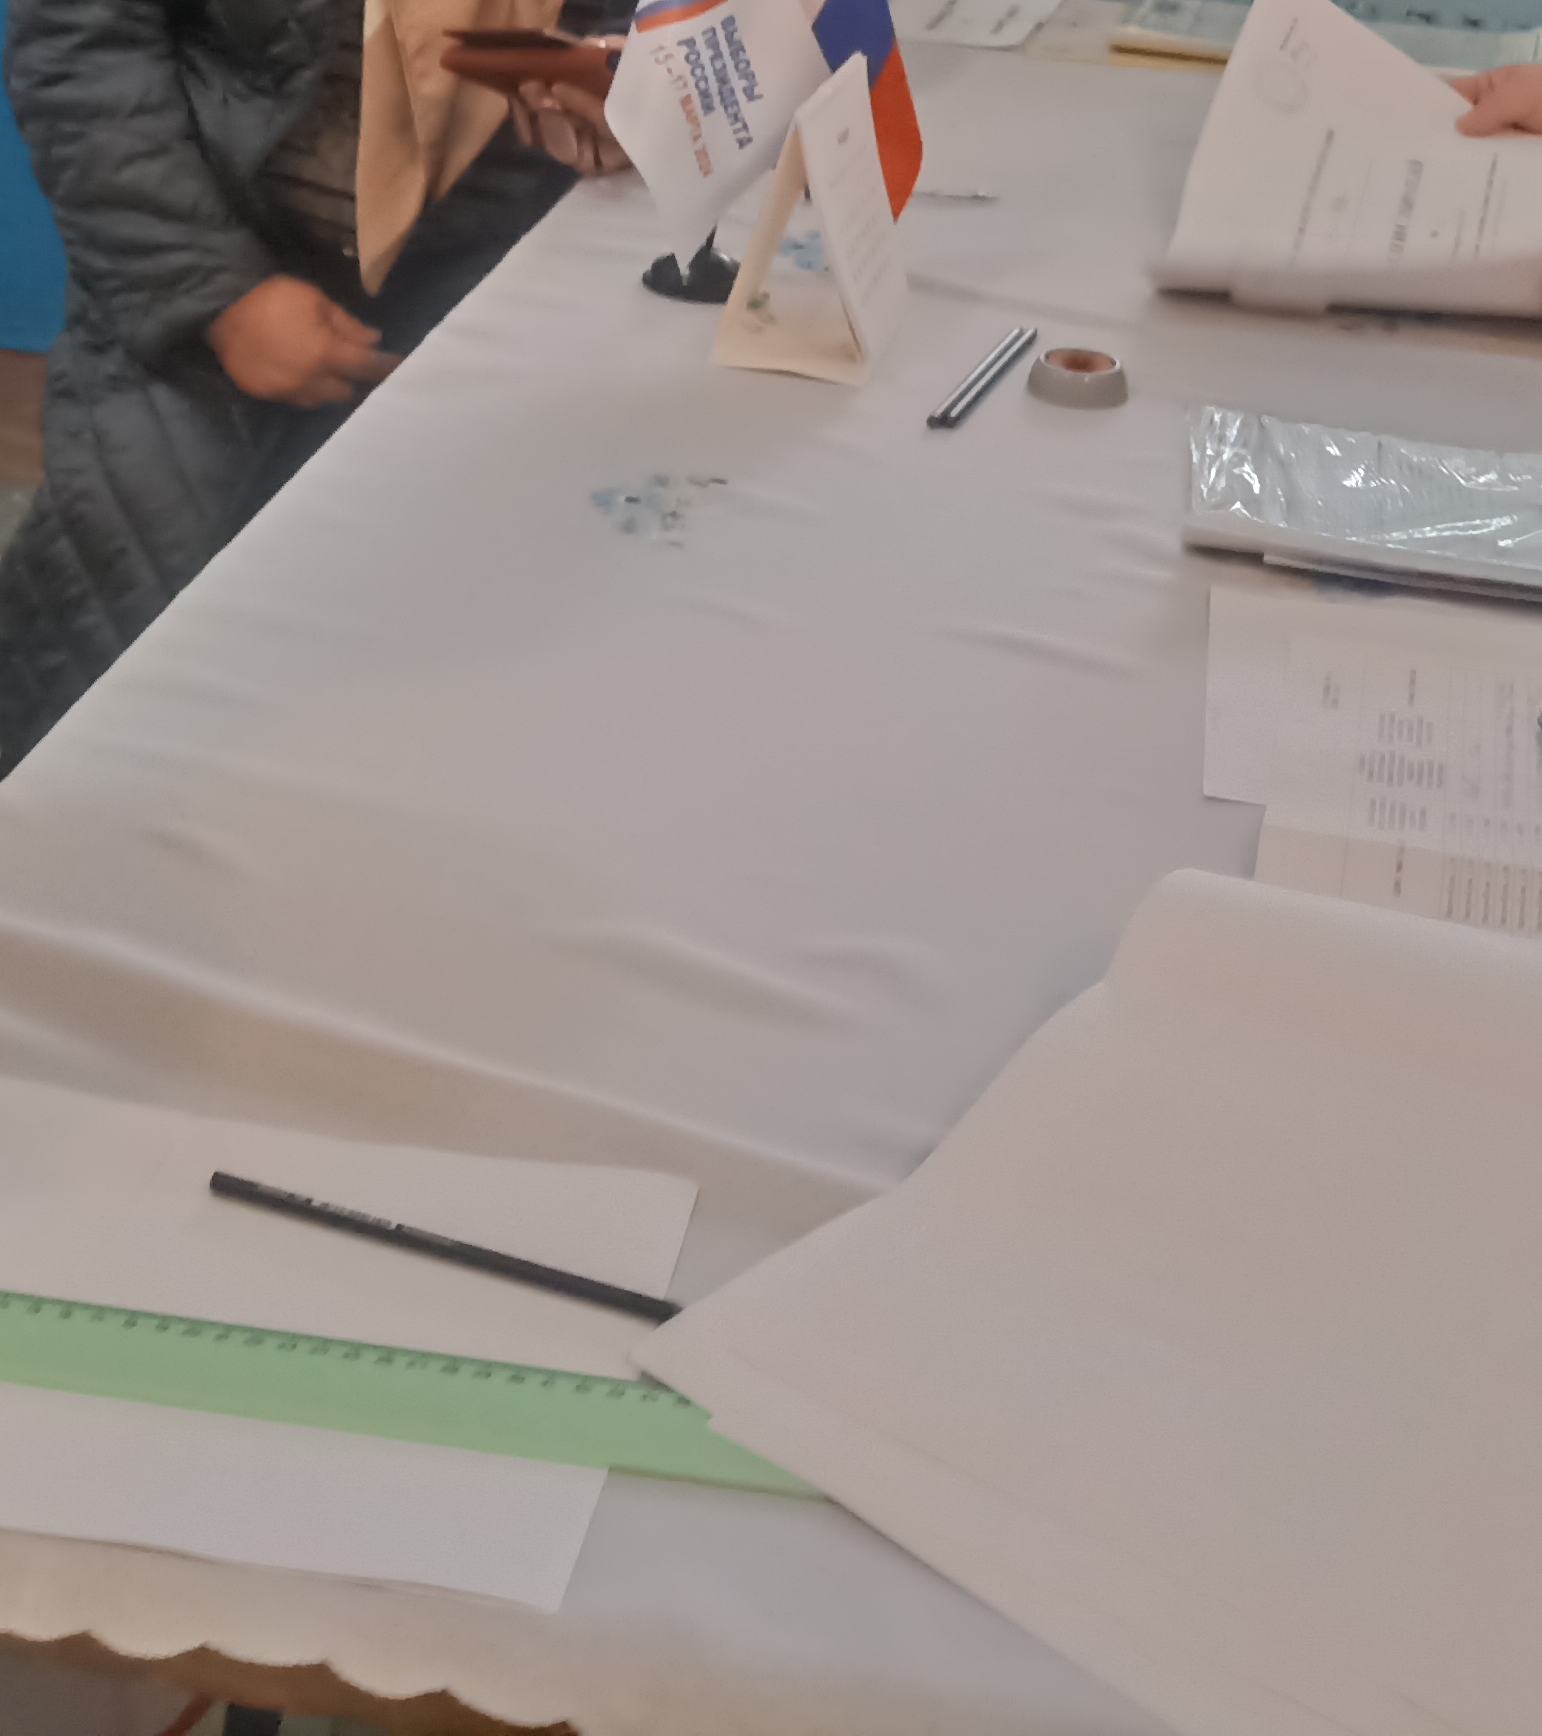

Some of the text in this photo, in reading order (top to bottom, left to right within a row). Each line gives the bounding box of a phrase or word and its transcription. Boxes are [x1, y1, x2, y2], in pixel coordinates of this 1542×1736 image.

[677, 36, 716, 117] РОССИИ
[702, 26, 753, 150] ПРЕЗИДЕНТА
[721, 14, 764, 102] ВЫБОРЫ
